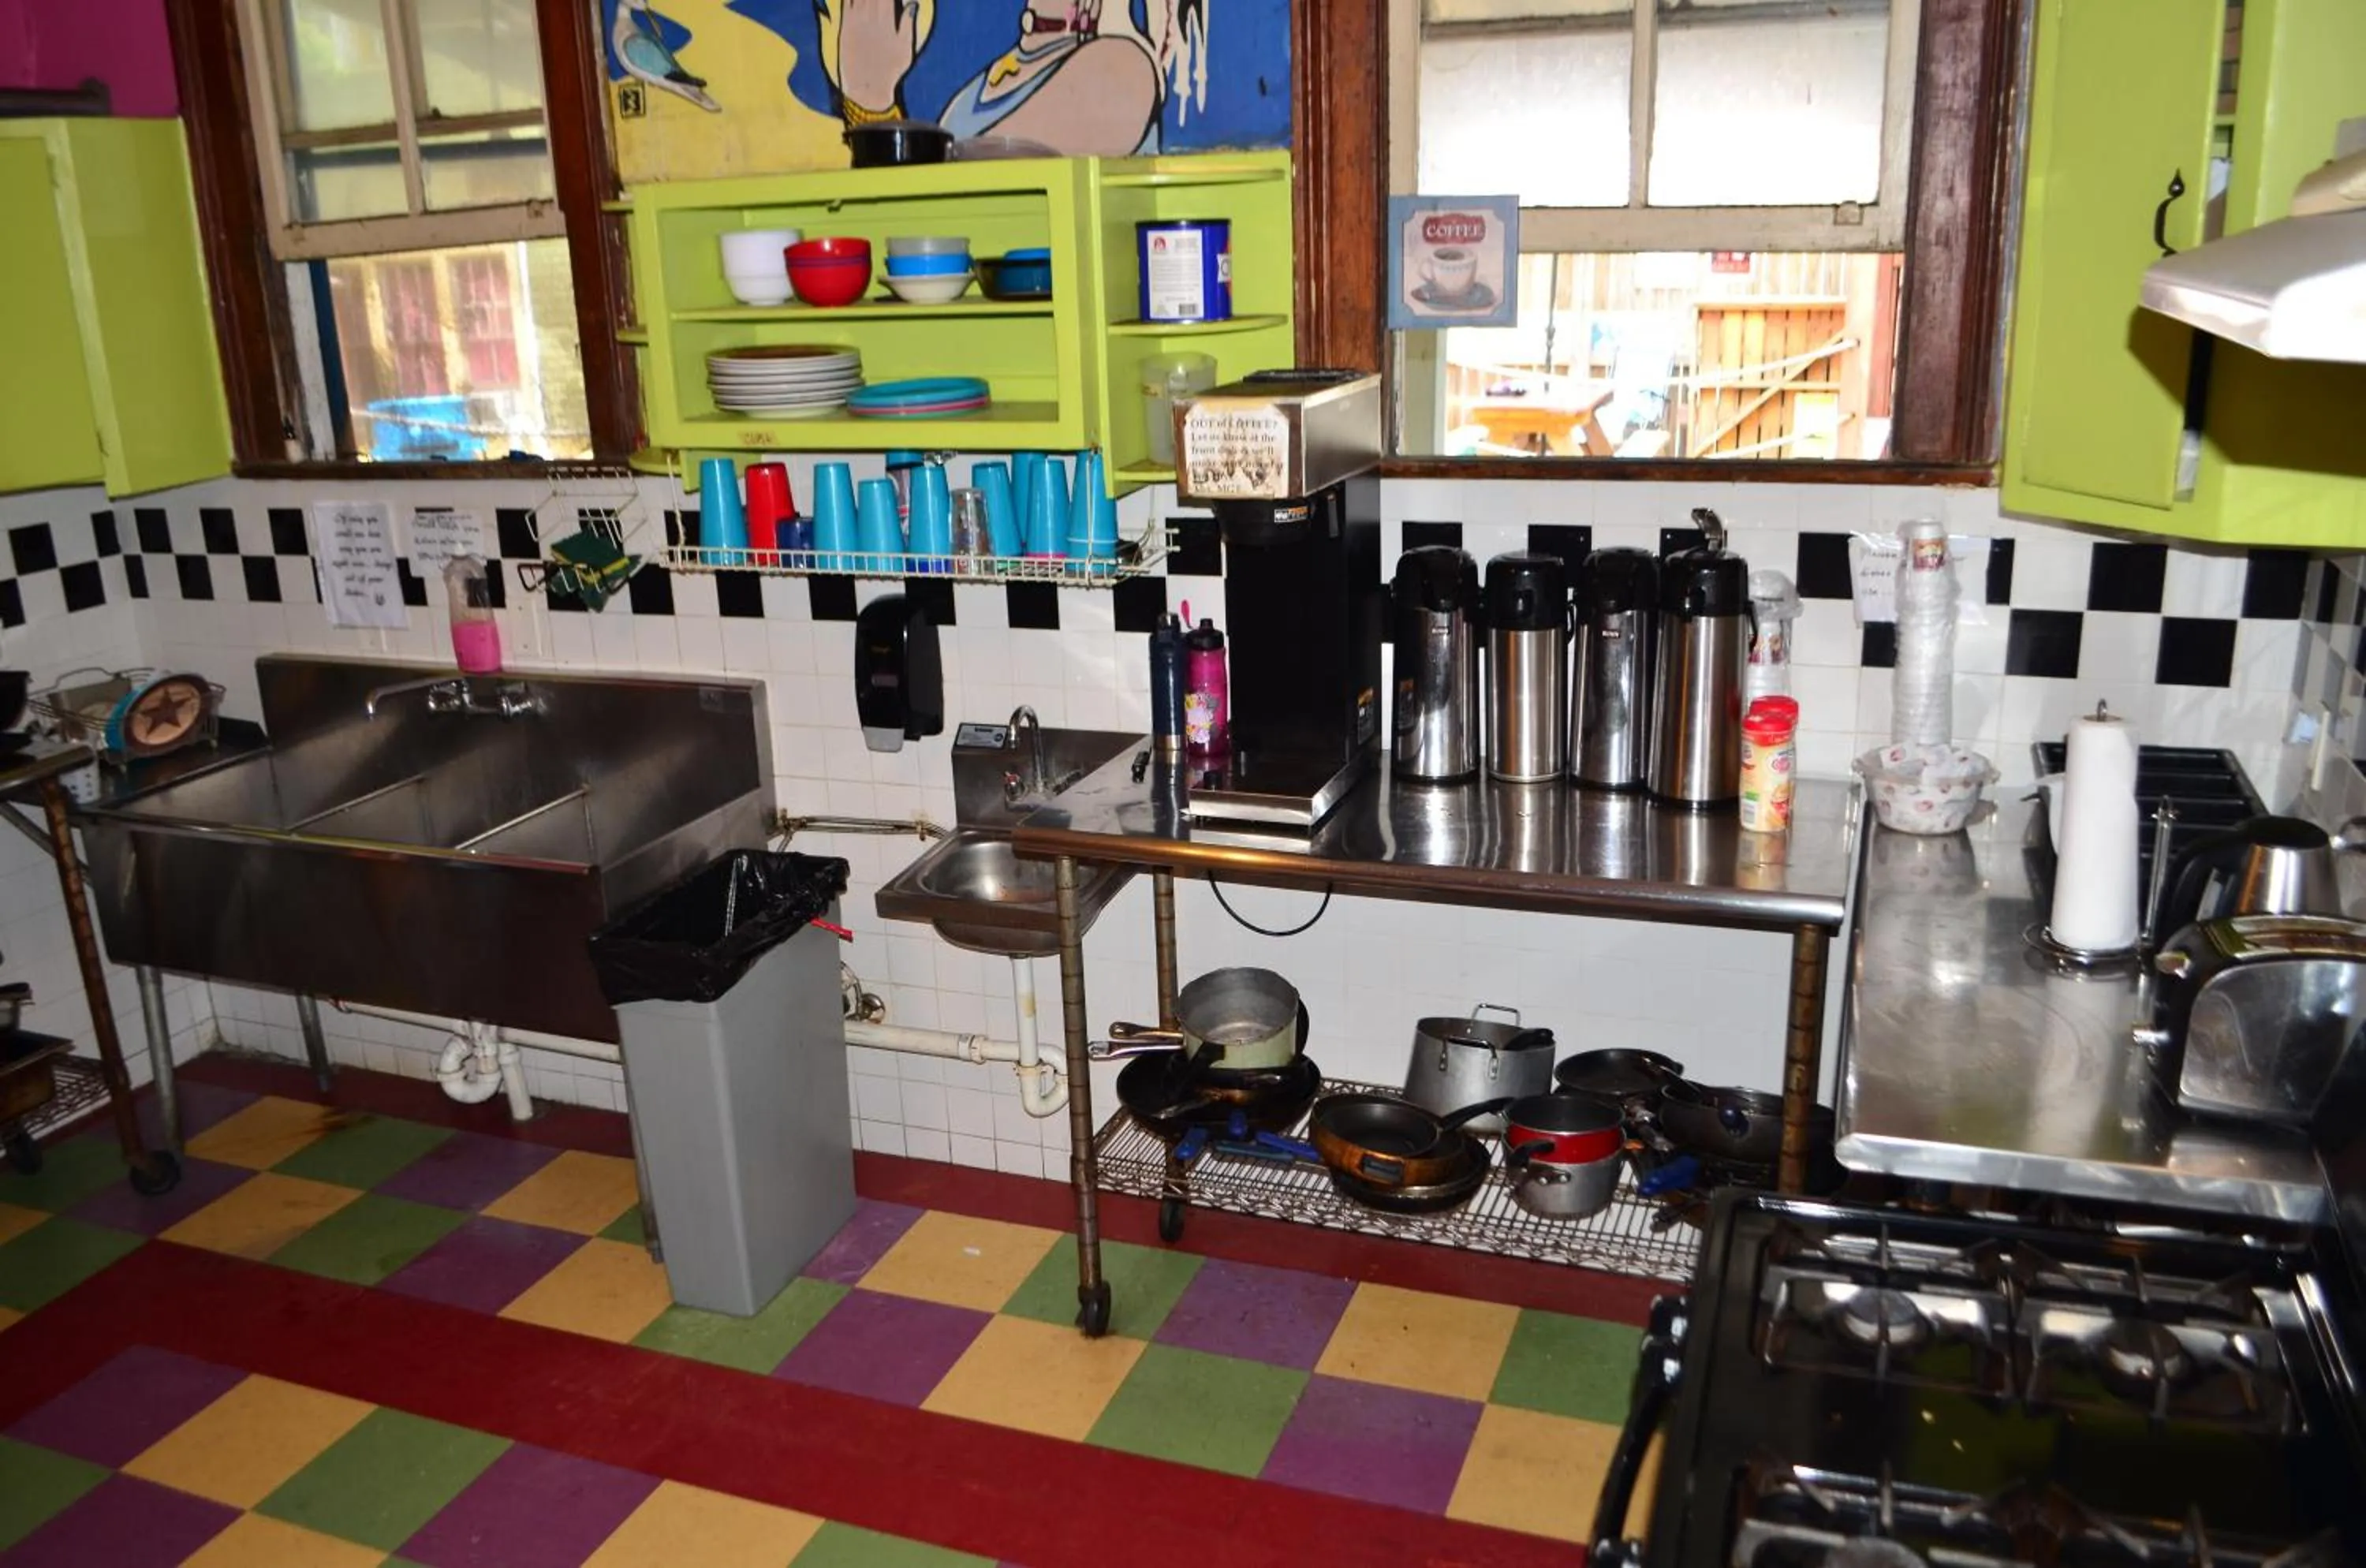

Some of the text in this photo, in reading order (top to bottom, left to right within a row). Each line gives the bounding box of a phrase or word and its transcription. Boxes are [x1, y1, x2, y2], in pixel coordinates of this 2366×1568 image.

[1427, 223, 1482, 237] COFFEE
[1191, 419, 1212, 428] OUT
[1192, 433, 1207, 442] Let
[1223, 432, 1247, 442] know
[1262, 432, 1275, 442] the
[1192, 446, 1215, 455] front
